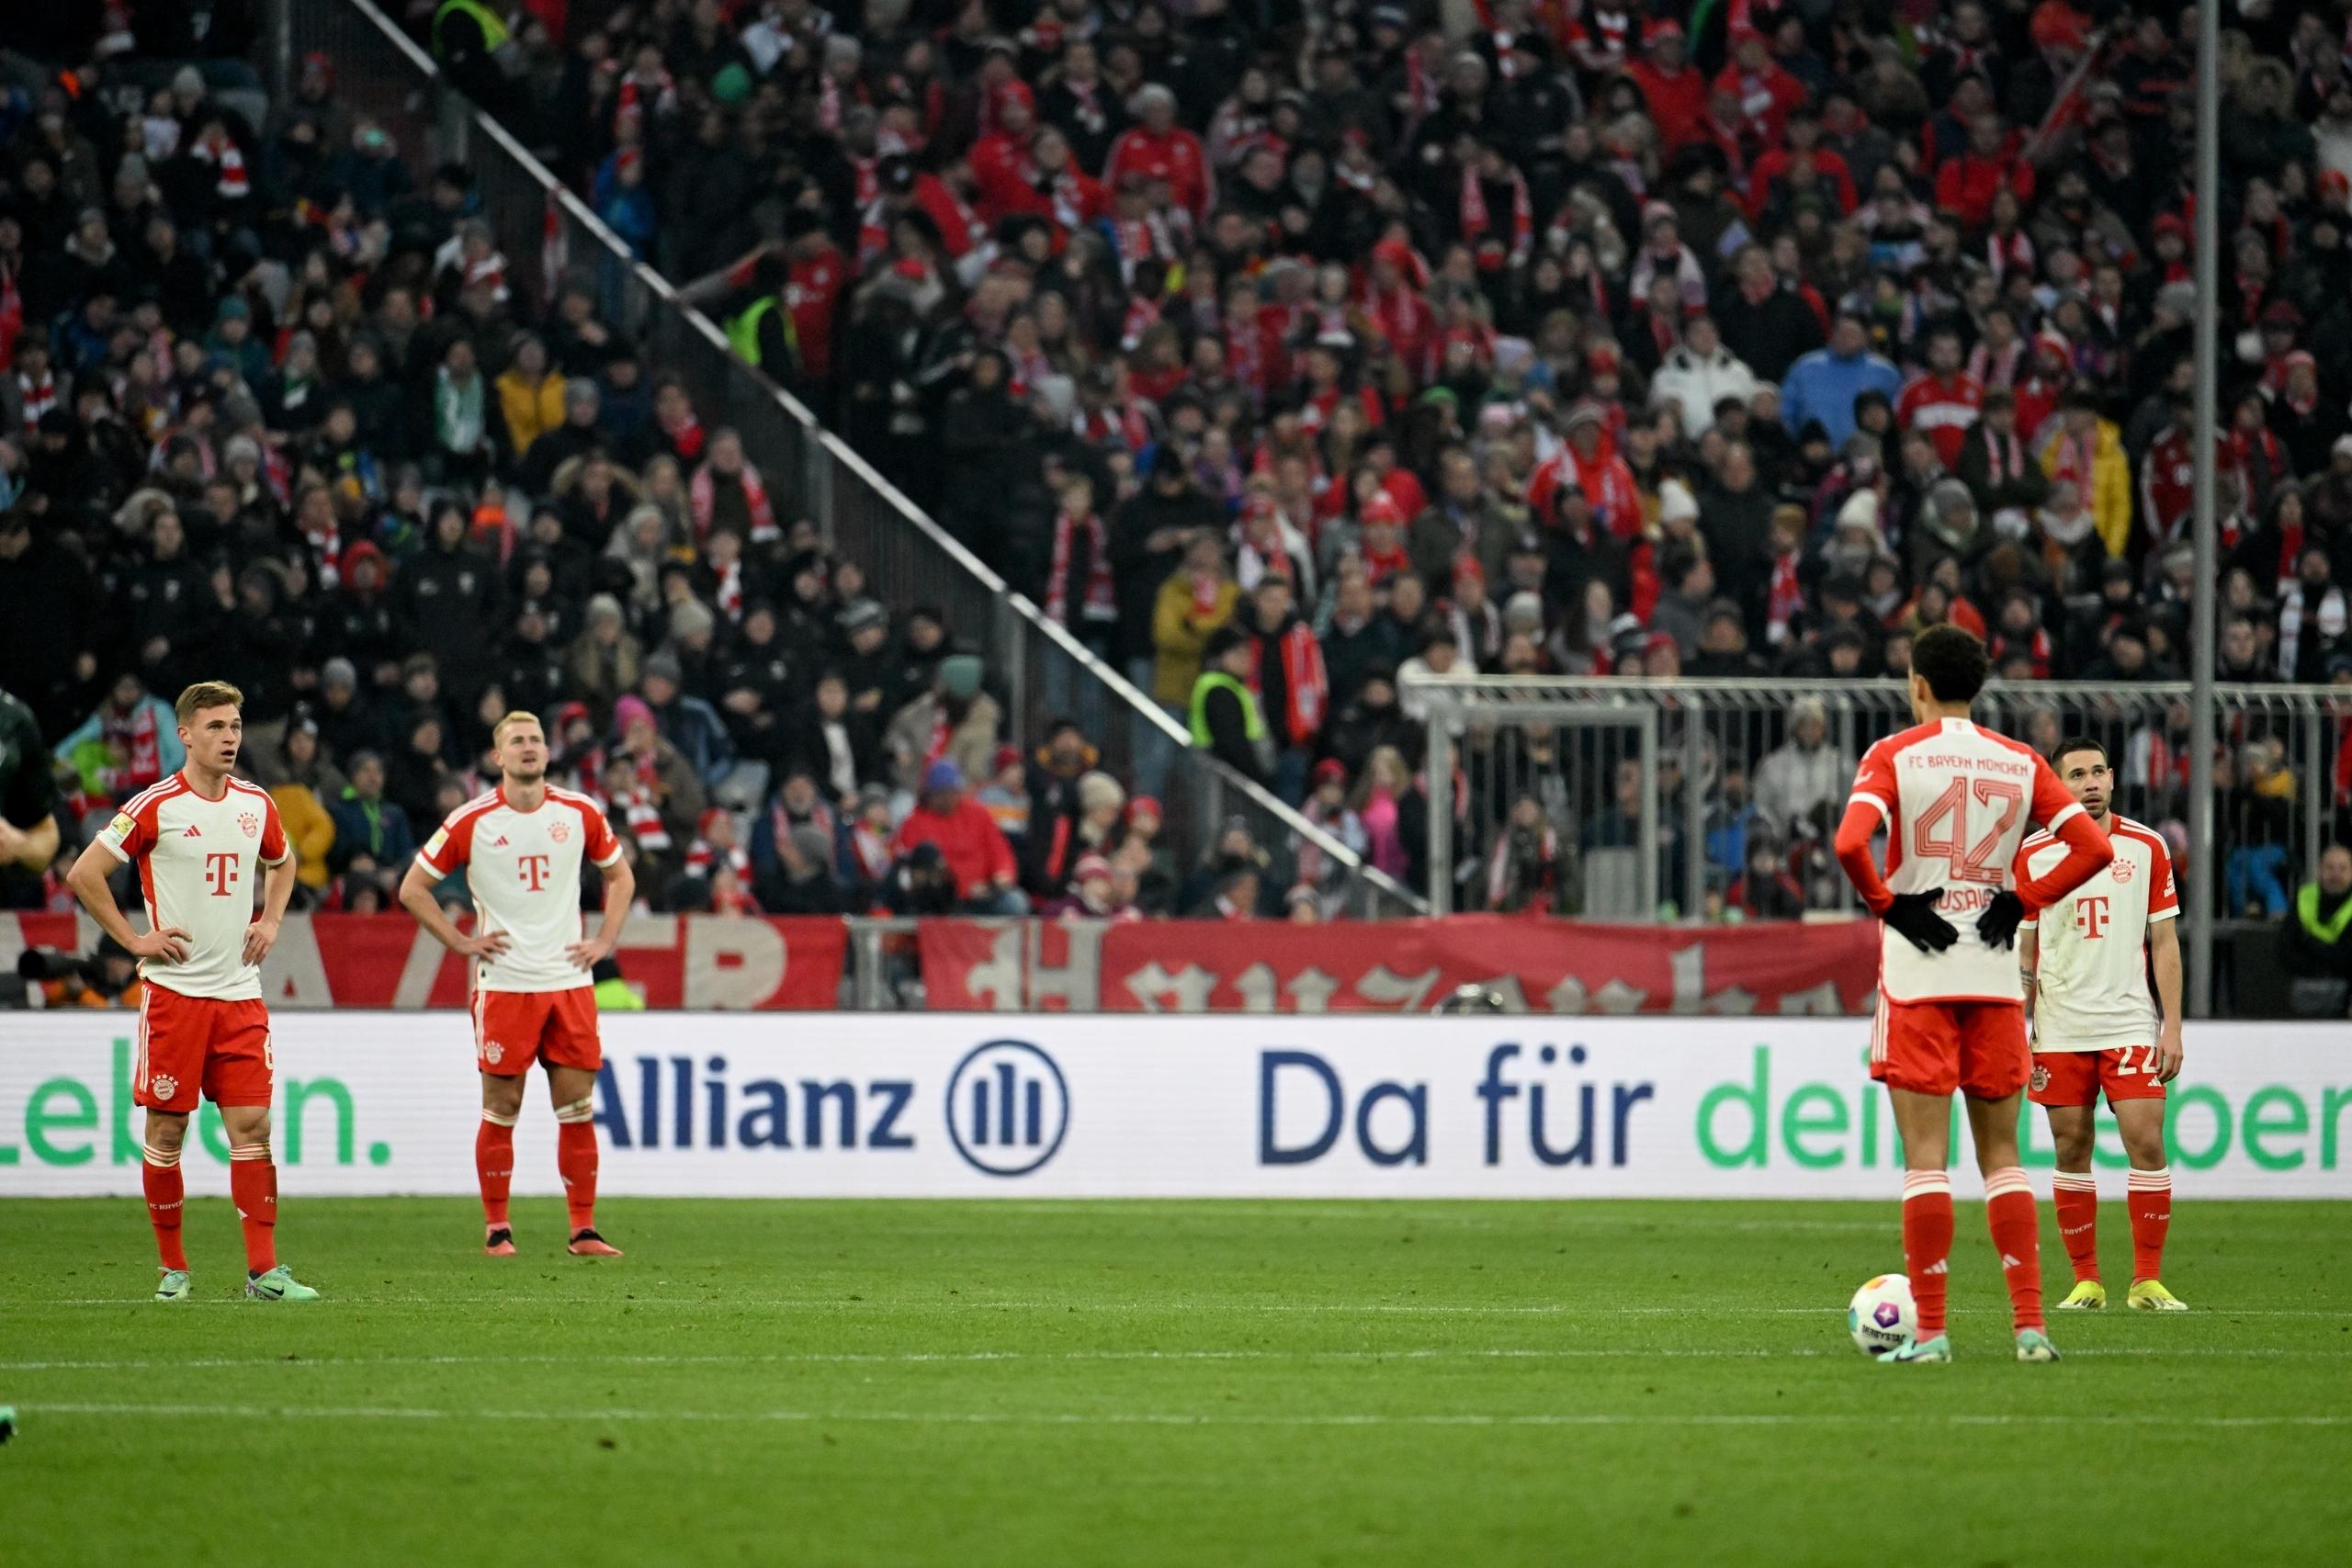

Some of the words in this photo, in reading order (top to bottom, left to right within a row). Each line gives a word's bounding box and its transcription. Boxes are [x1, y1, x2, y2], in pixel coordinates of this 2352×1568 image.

[1908, 755, 1924, 769] FC
[1928, 755, 1973, 770] BAYERN
[1915, 776, 2023, 883] 42
[0, 1038, 392, 1168] ebn.
[593, 1056, 915, 1148] Allianz
[1260, 1051, 1428, 1166] Da
[1476, 1043, 1653, 1166] für
[2017, 1070, 2352, 1171] Lbe
[2114, 1045, 2158, 1076] 22
